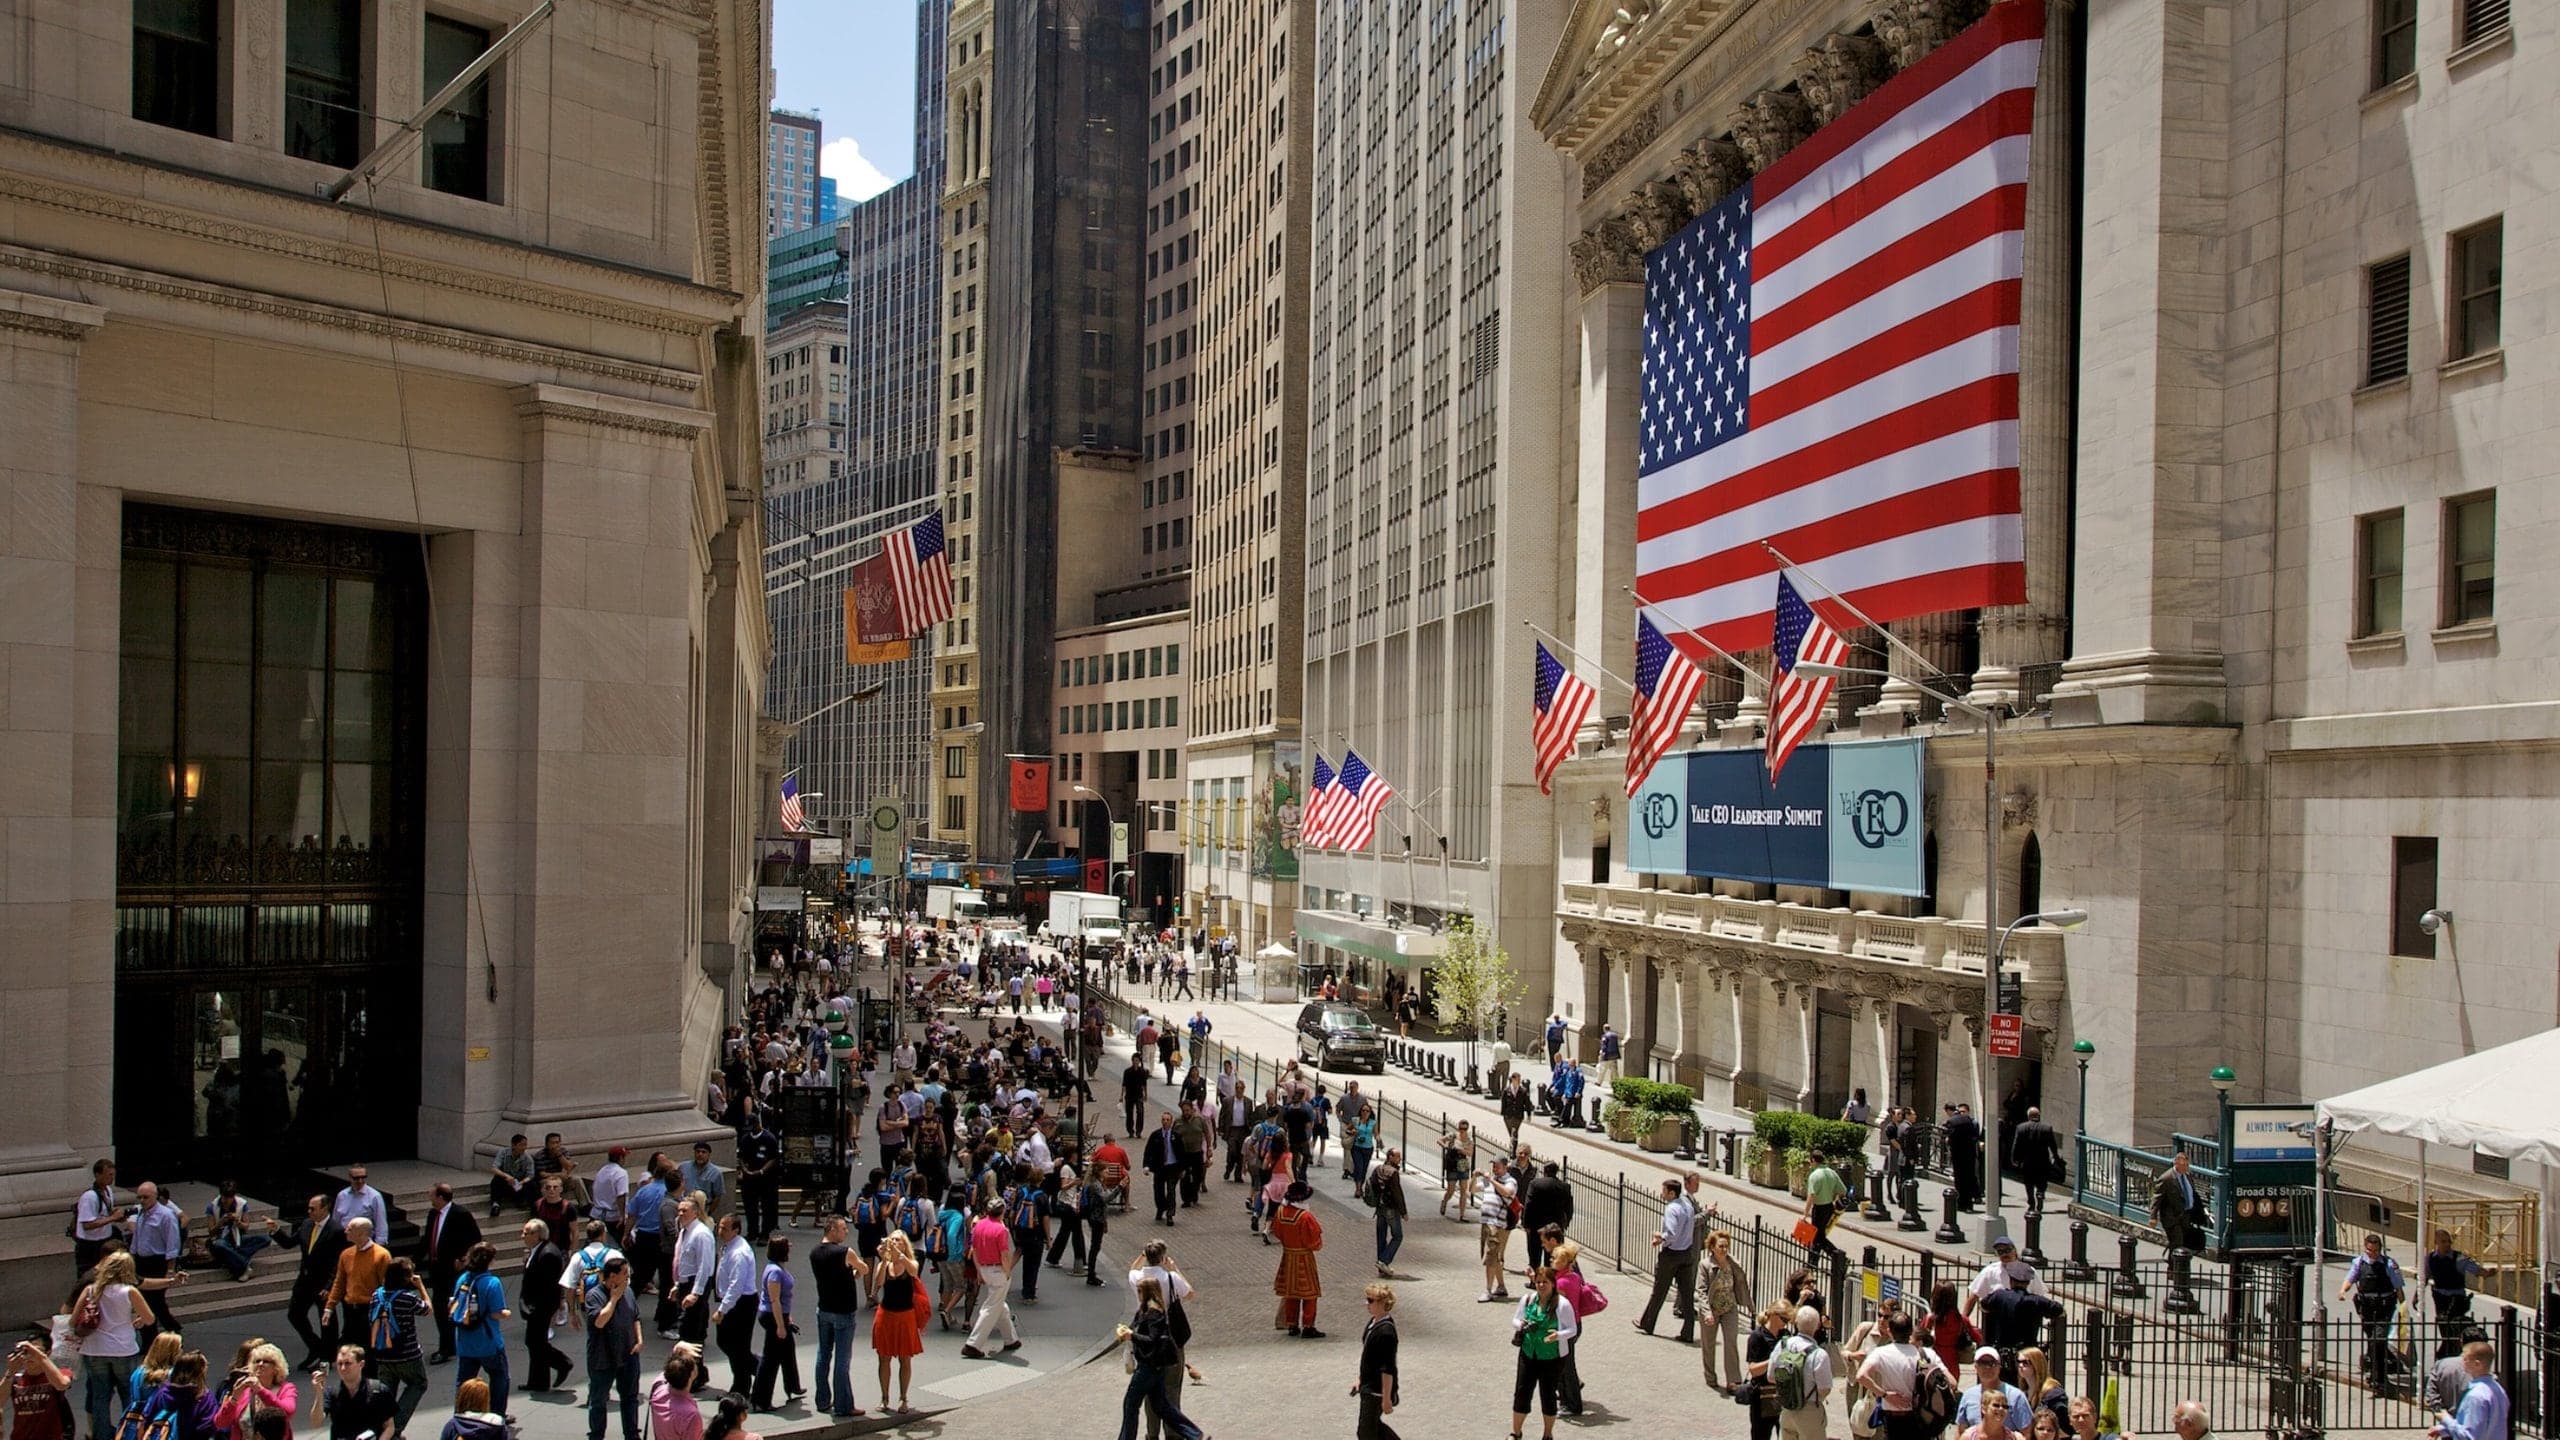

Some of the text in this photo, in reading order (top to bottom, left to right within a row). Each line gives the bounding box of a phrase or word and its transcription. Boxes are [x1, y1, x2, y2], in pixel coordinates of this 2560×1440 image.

[1711, 804, 1729, 824] CEO
[2000, 1019, 2012, 1028] NO
[1991, 1029, 2020, 1038] STANDING
[1992, 1037, 2018, 1046] ANYTIME
[2246, 1121, 2273, 1133] ALWAYS
[2123, 1157, 2154, 1178] Subway
[2236, 1187, 2265, 1197] Broad
[2267, 1187, 2278, 1197] St
[2259, 1202, 2271, 1214] M
